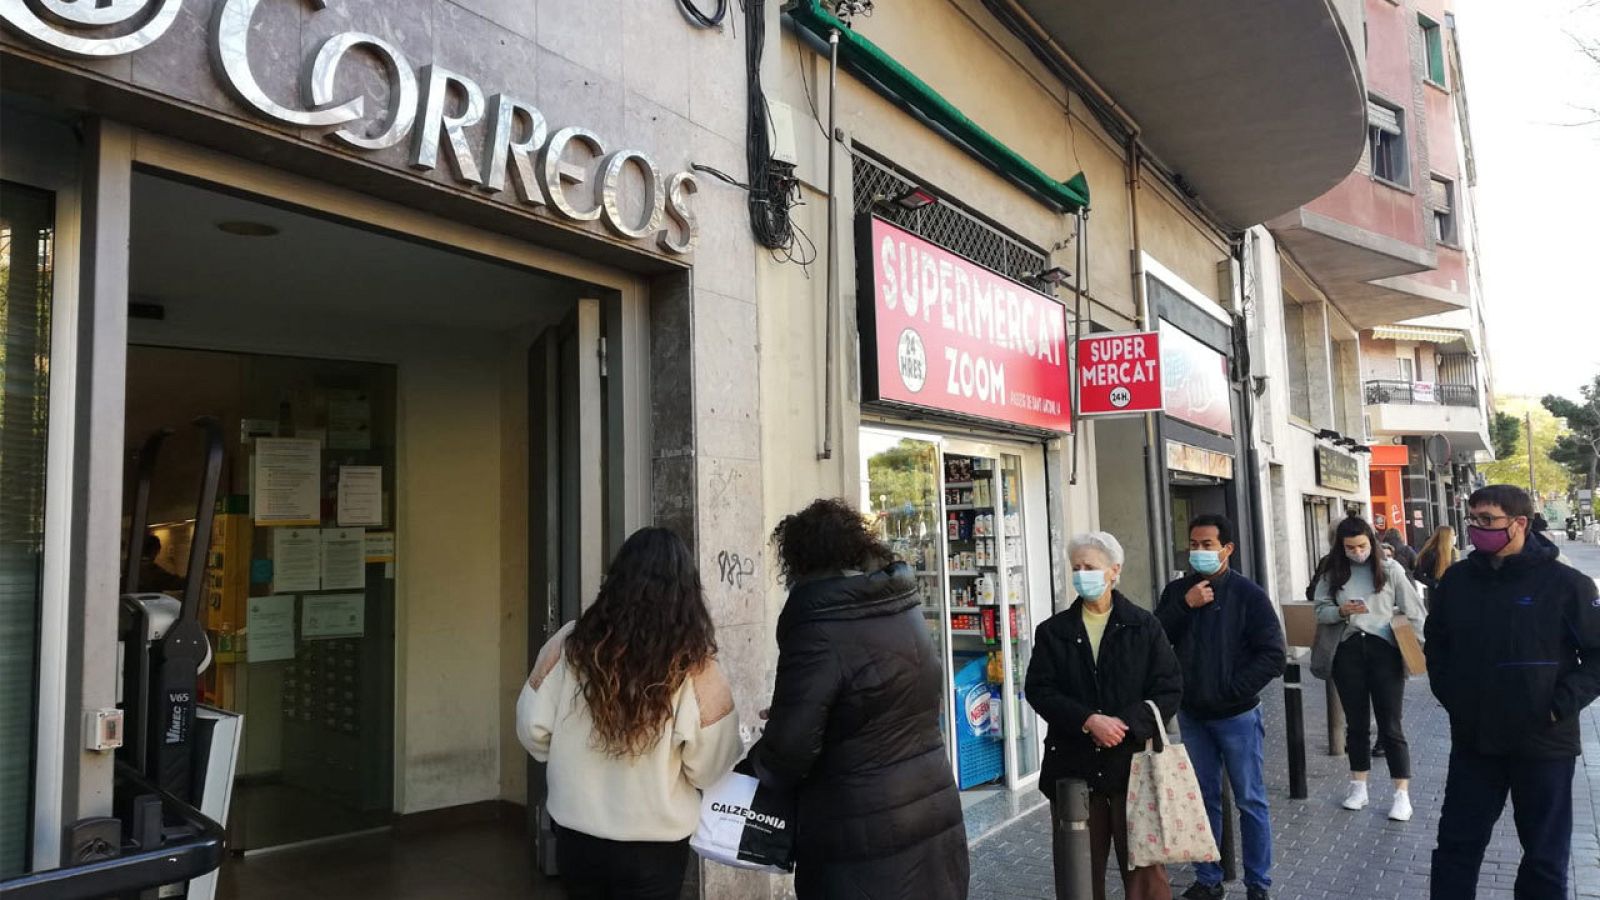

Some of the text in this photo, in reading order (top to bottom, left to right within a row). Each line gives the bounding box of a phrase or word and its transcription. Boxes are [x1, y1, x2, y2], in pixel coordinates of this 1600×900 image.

[881, 235, 1062, 366] SUPERMERCAT
[905, 334, 916, 355] 24
[1090, 337, 1146, 362] SUPER
[944, 346, 1007, 406] ZOOM
[1082, 360, 1156, 387] MERCAT
[169, 693, 190, 703] V65
[710, 801, 786, 830] CALZEDONIA
